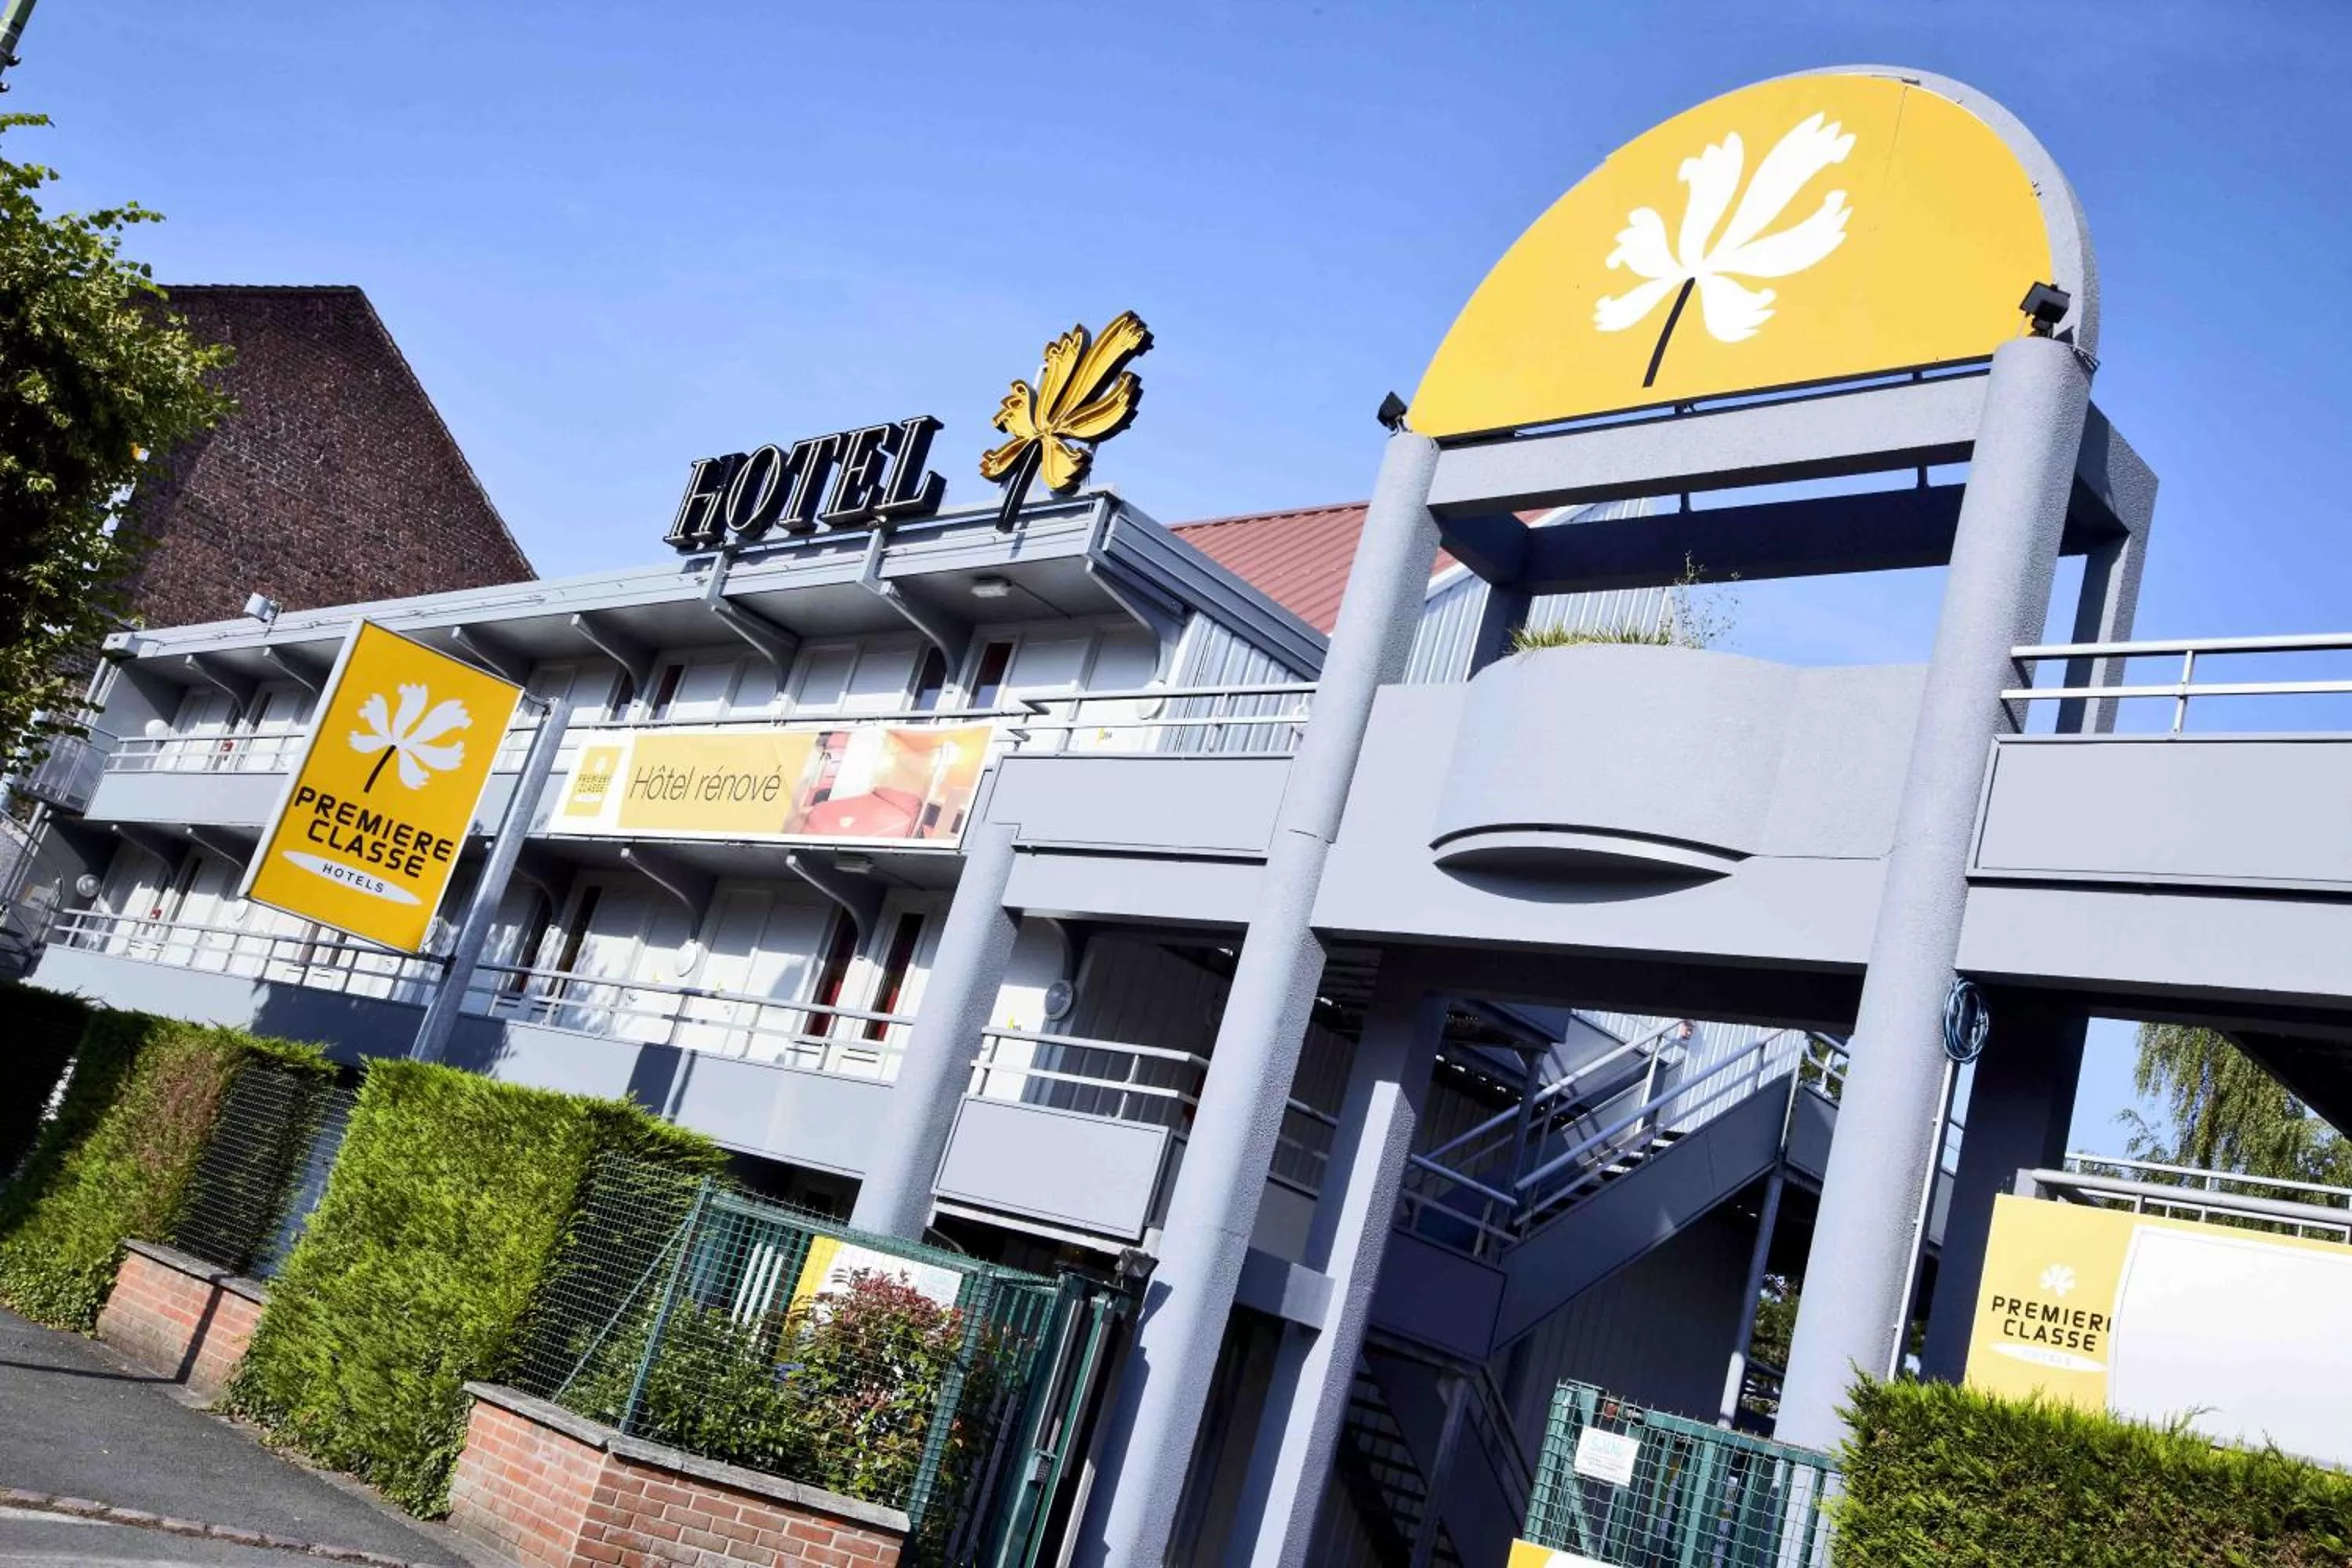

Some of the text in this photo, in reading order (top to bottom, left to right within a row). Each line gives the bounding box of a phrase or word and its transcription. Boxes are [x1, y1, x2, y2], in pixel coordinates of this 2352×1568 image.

[663, 415, 947, 549] HOTEL
[629, 765, 782, 802] Hôtel rénové
[294, 786, 454, 862] PREMIERE
[307, 818, 426, 878] CLASSE
[322, 862, 385, 894] HOTELS
[2003, 1318, 2097, 1352] CLASSE
